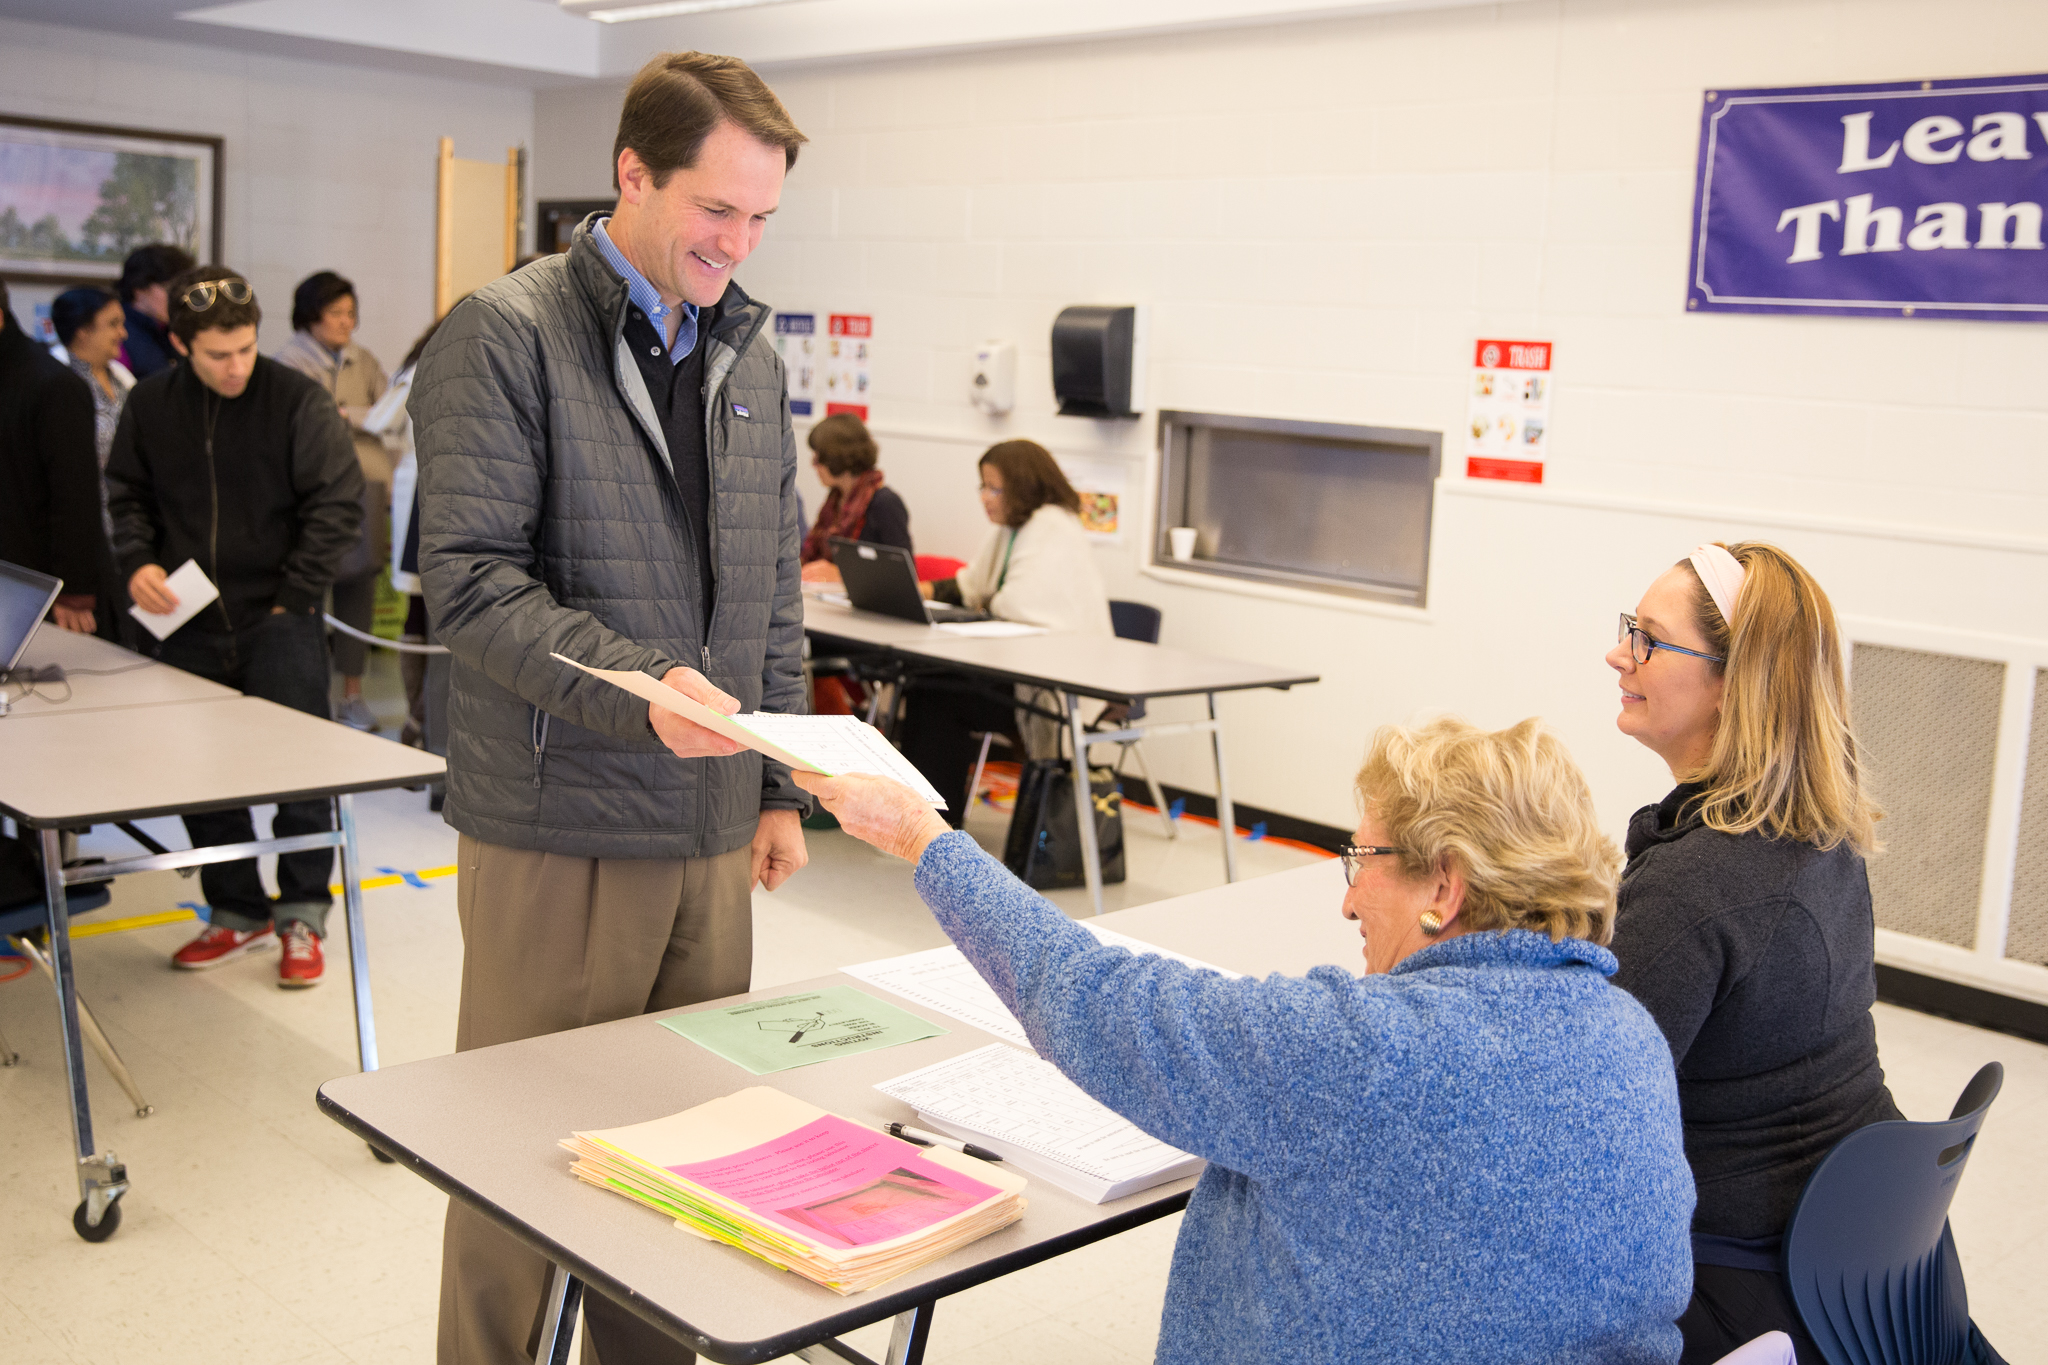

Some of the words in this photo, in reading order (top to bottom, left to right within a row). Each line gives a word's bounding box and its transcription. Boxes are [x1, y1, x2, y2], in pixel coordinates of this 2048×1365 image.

[1837, 111, 2048, 174] Lea
[1776, 193, 2046, 264] Than
[1509, 346, 1547, 368] TRASH
[811, 1030, 883, 1047] INSTRUCTIONS
[835, 1037, 872, 1046] VOTING
